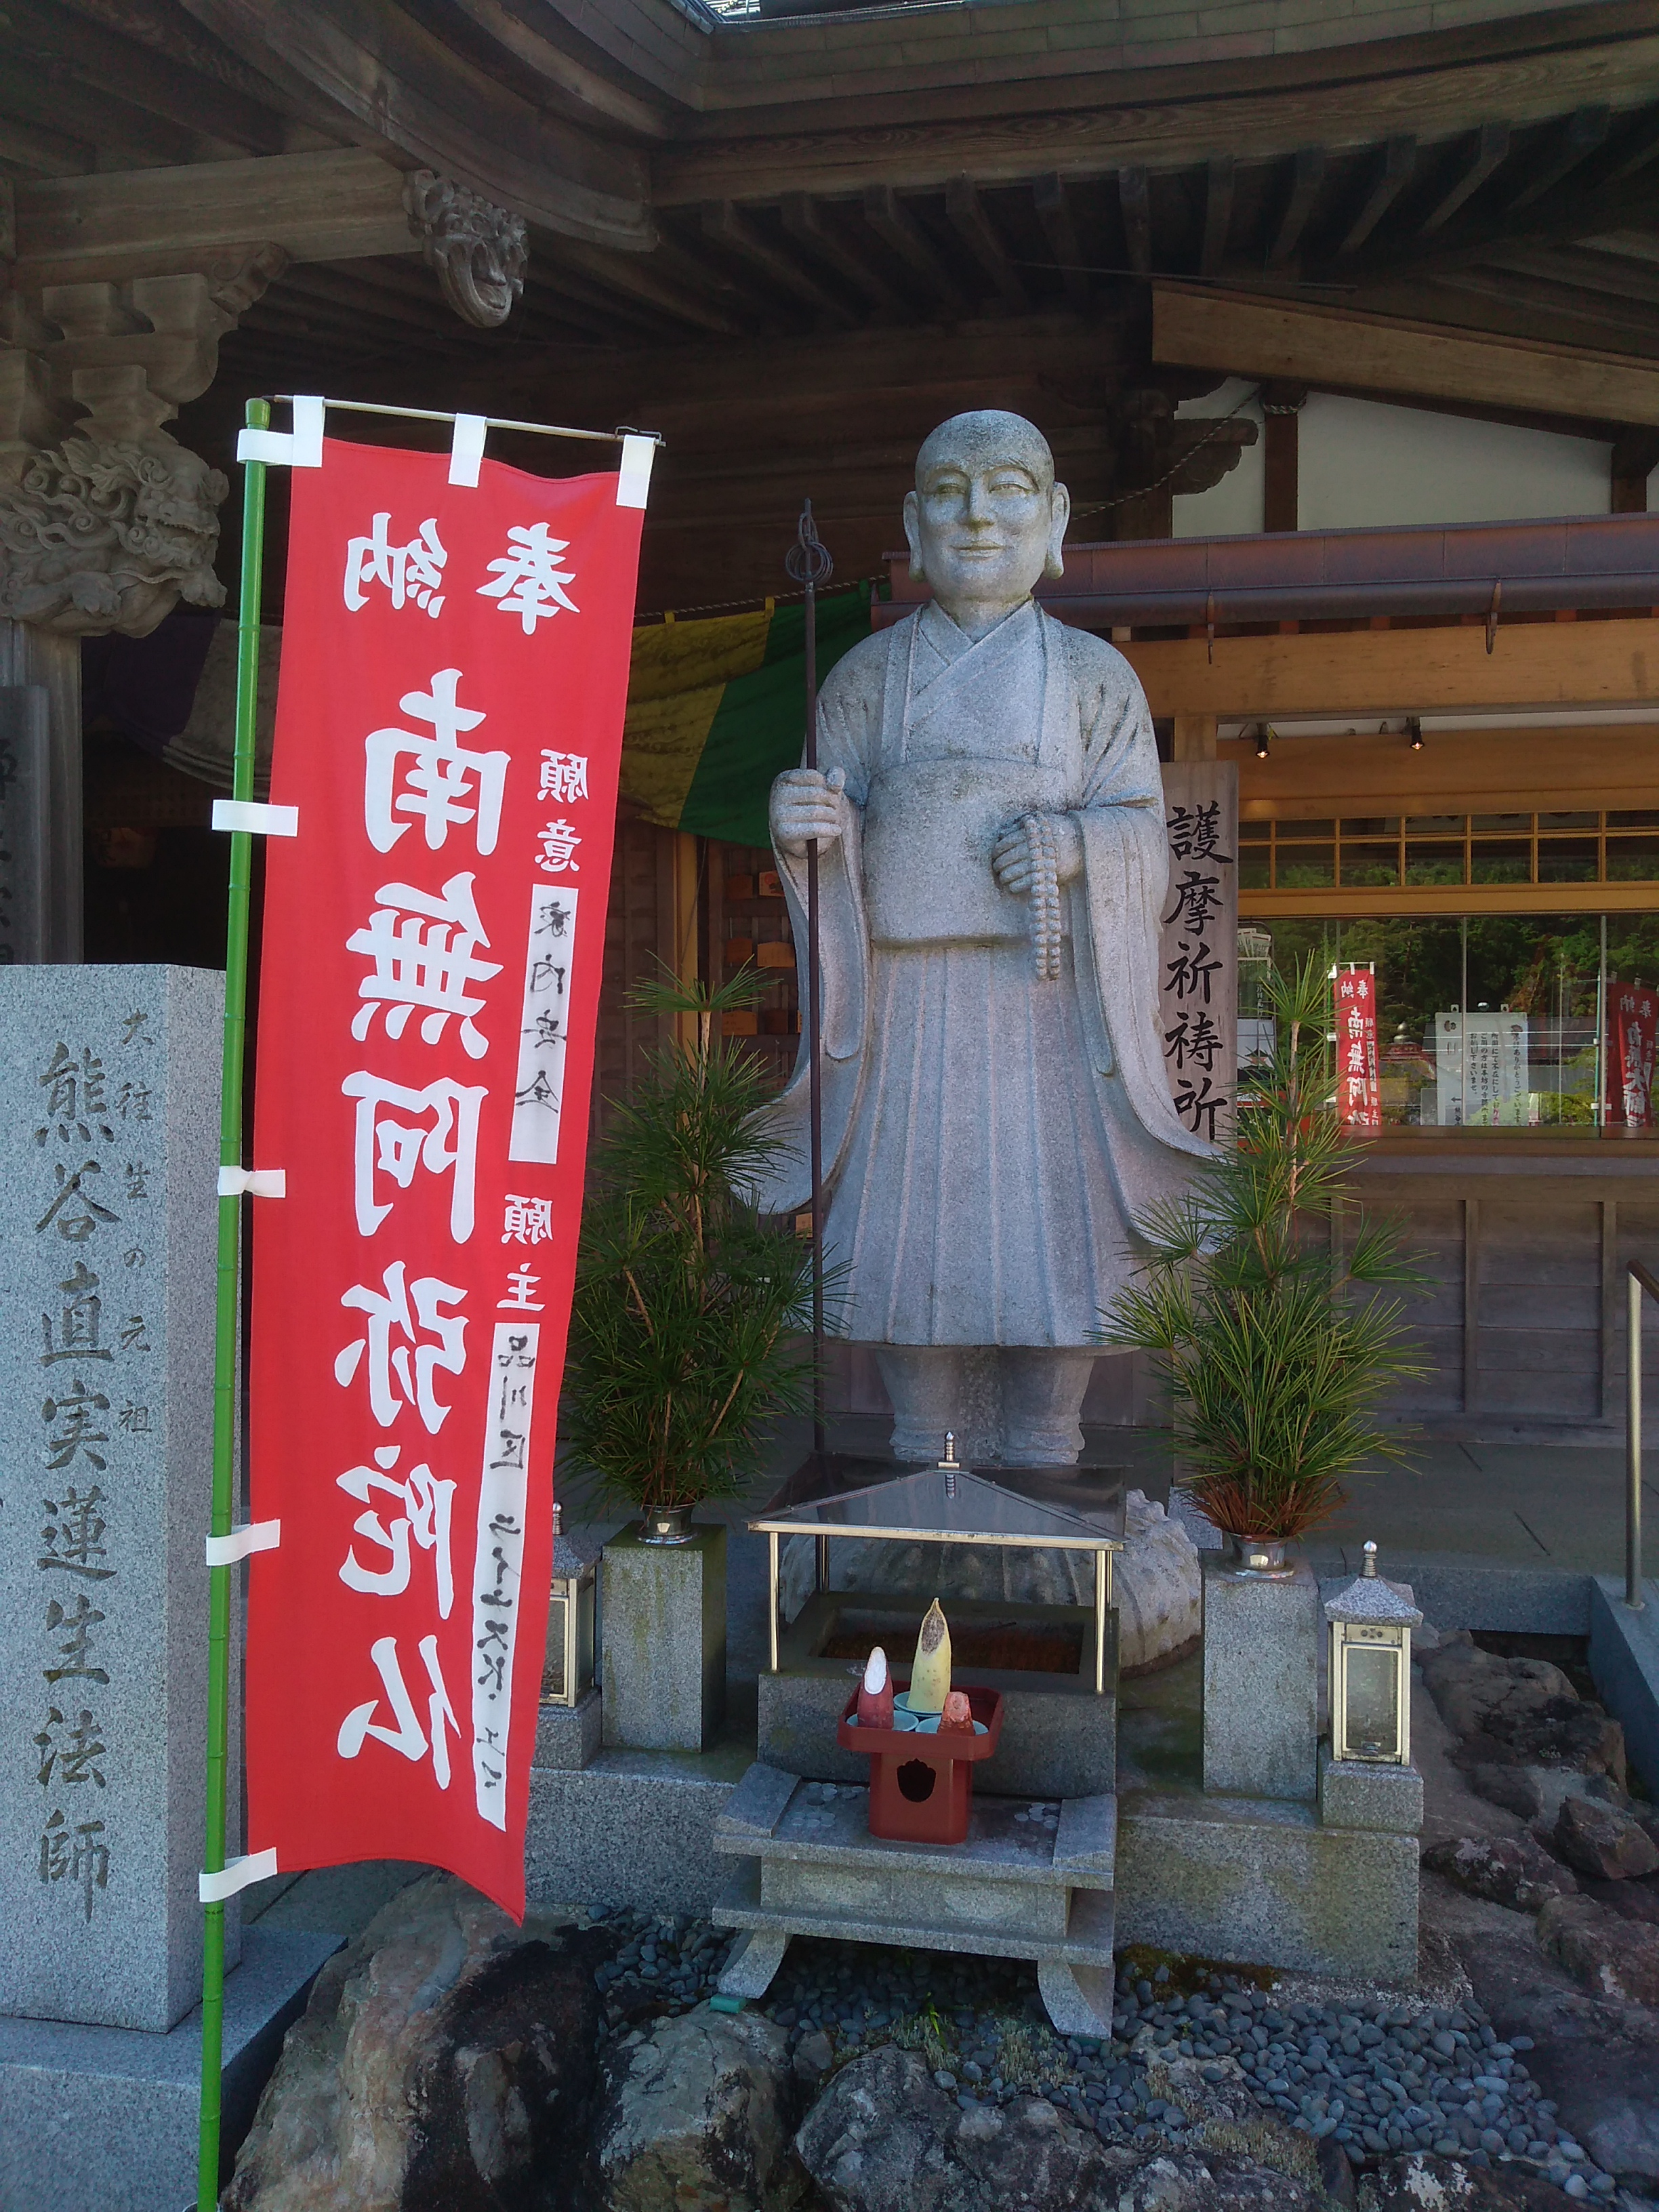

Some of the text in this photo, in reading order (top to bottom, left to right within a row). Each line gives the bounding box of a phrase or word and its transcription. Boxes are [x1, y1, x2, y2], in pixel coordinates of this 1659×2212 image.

[1163, 800, 1233, 1141] 護摩祈祷所
[117, 1008, 153, 1433] 大往生の元祖
[34, 1041, 123, 1925] 熊谷直実蓮生法師
